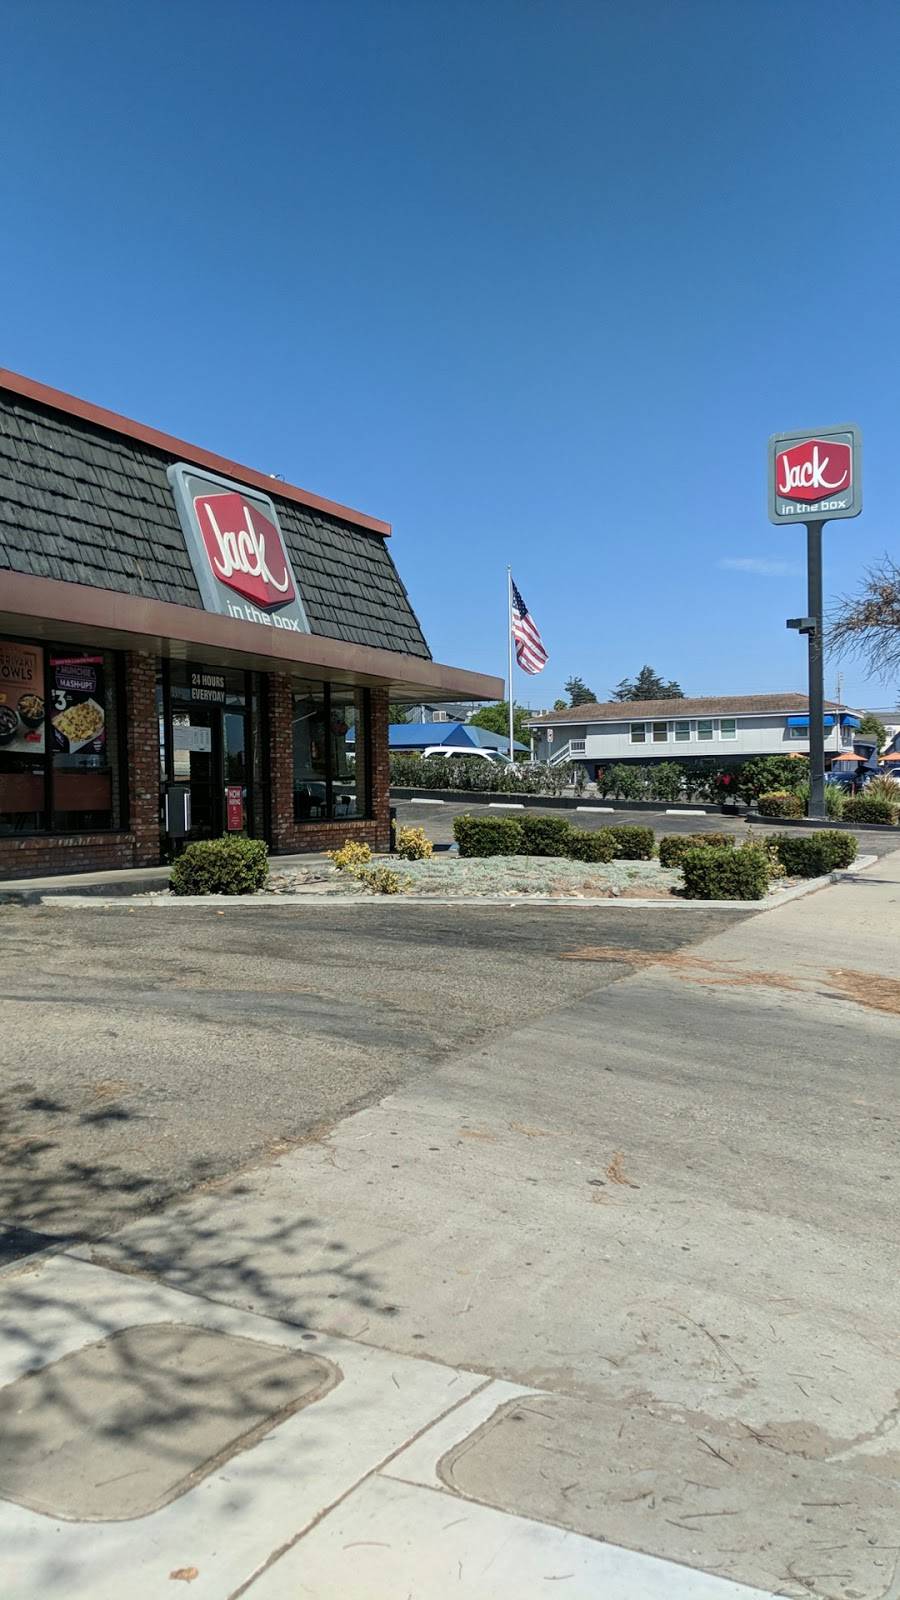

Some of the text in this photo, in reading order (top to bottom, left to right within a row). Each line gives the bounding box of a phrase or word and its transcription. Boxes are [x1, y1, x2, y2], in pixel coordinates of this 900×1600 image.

[779, 446, 847, 493] Jack
[782, 500, 846, 514] in the box
[204, 503, 288, 592] Jack
[227, 600, 301, 632] in the box
[191, 673, 225, 687] 24 HOURS
[191, 688, 225, 703] EVERYDAY
